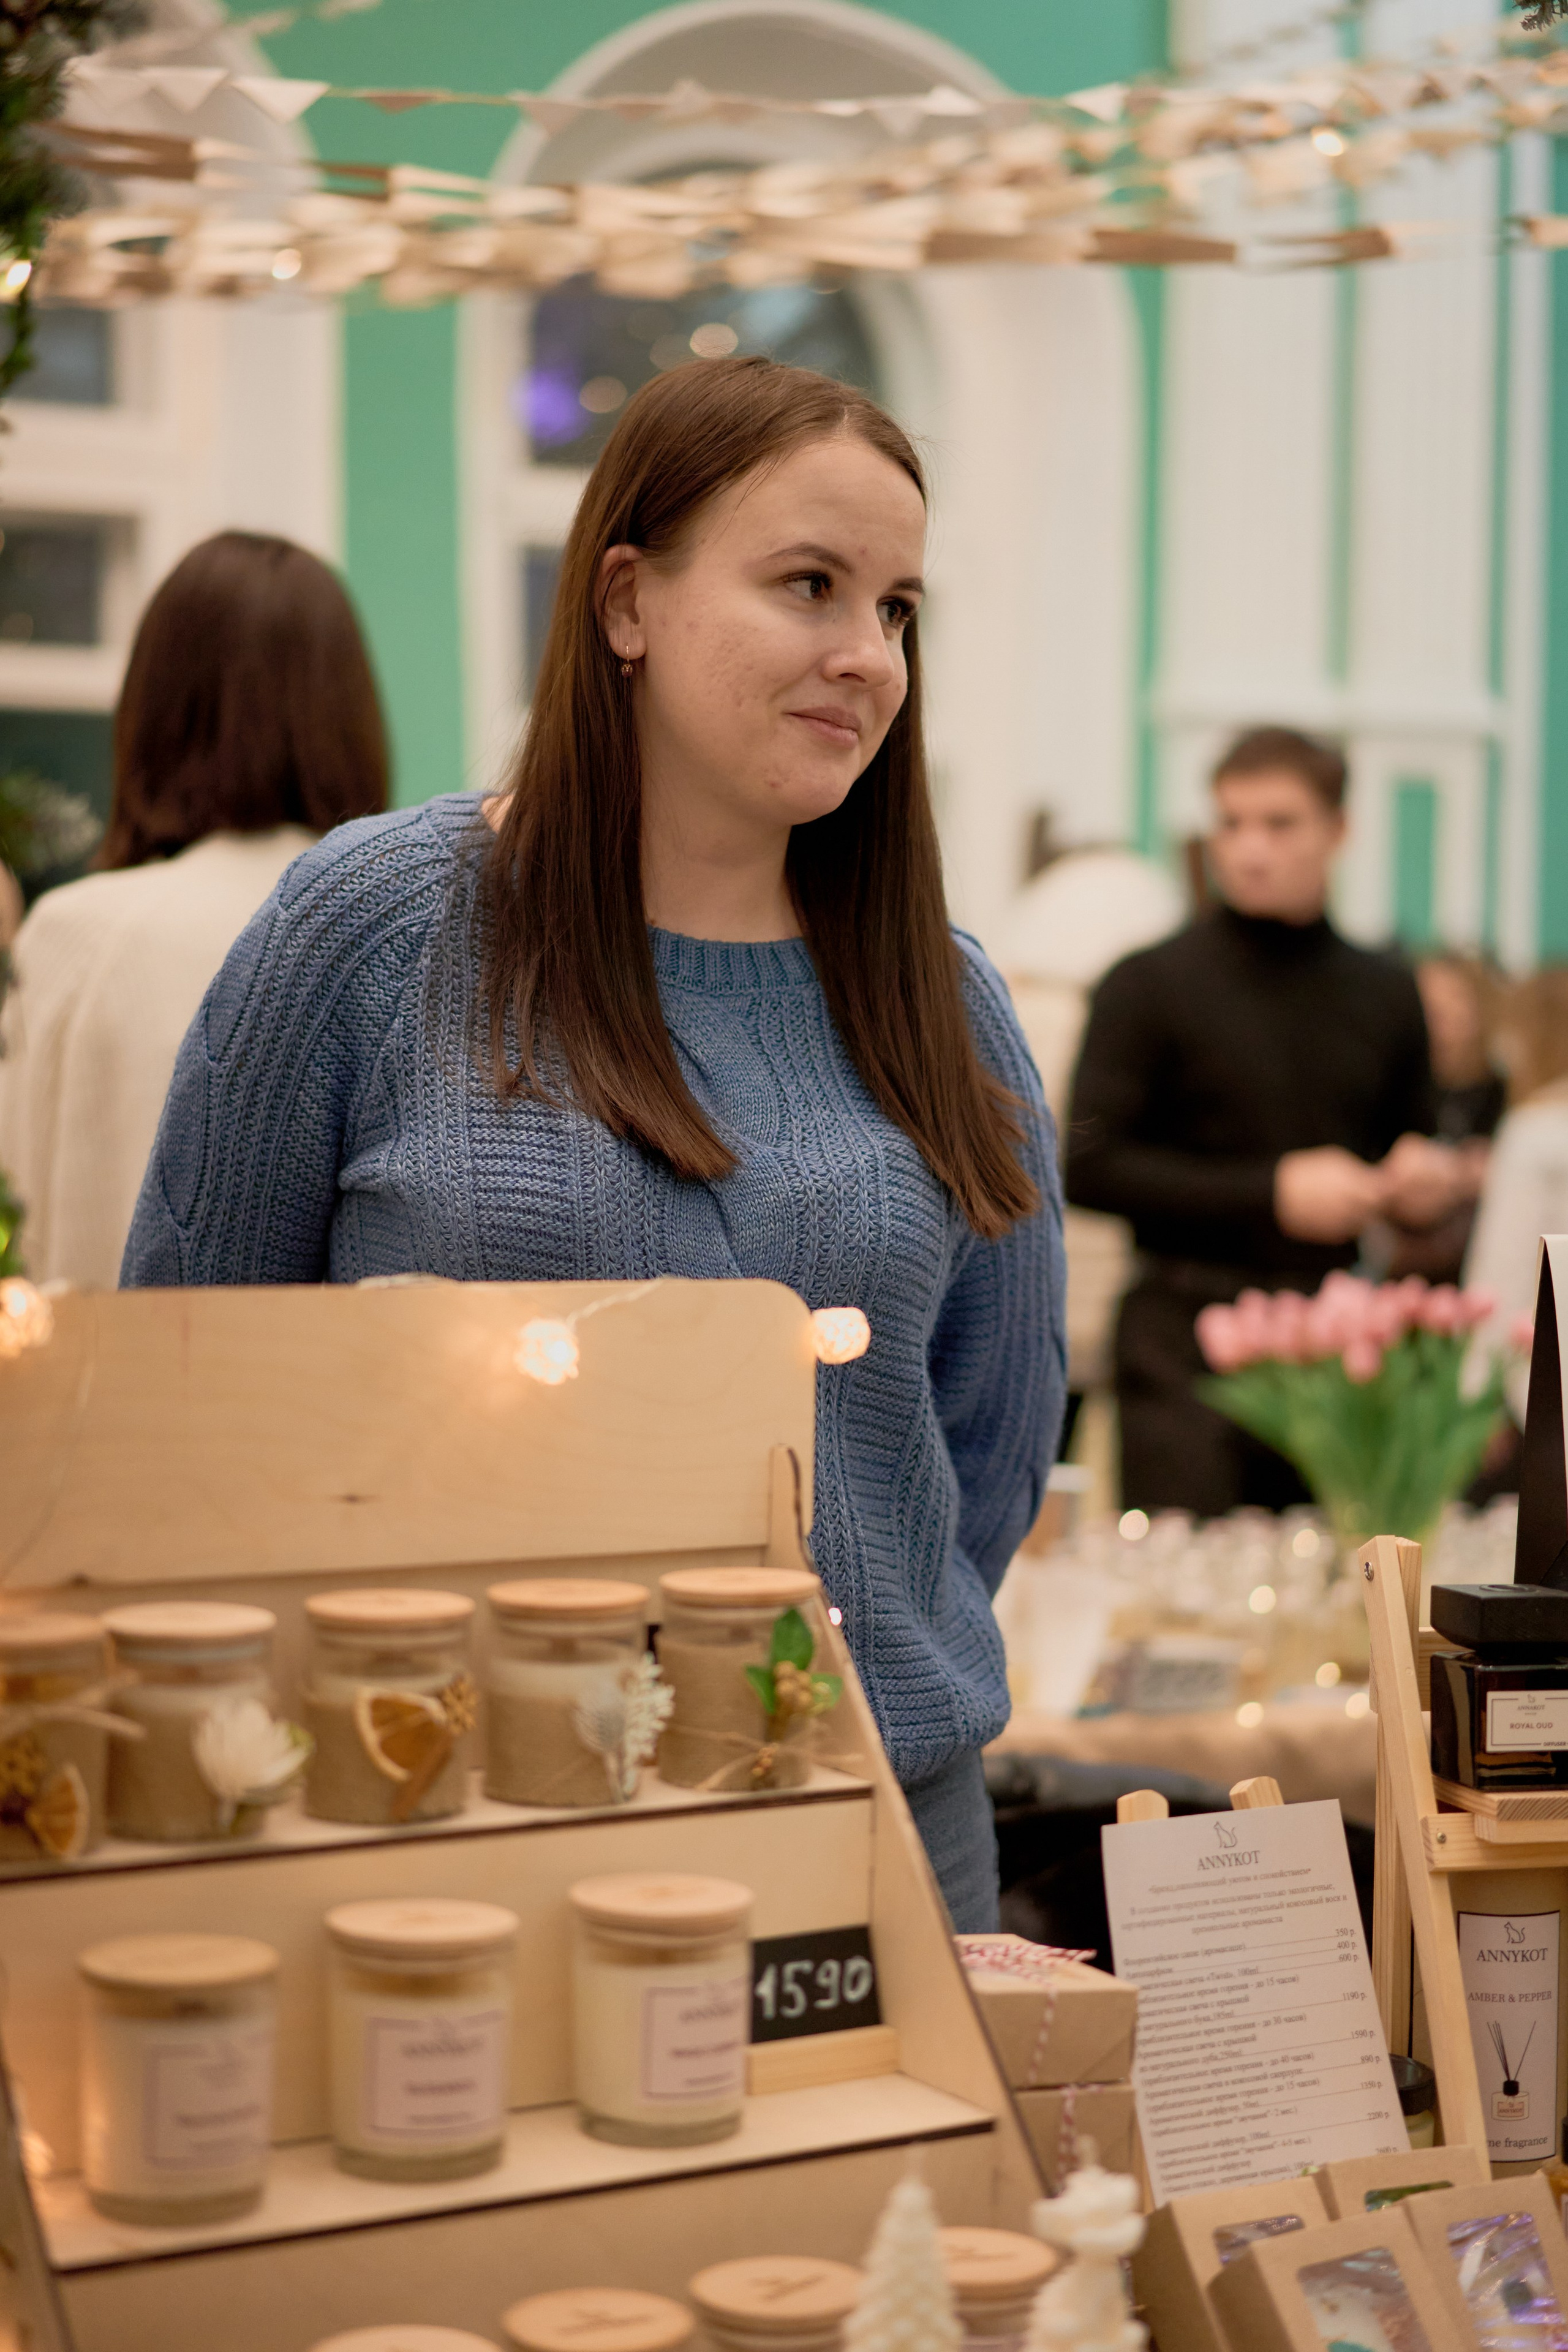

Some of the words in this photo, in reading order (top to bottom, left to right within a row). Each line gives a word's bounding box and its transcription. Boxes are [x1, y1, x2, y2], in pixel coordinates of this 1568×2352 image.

[1197, 1850, 1260, 1871] ANNYKOT
[1262, 1889, 1286, 1898] только
[1289, 1883, 1335, 1894] экологичные,
[1238, 1901, 1284, 1915] натуральный
[1286, 1896, 1324, 1907] кокосовый
[1241, 1915, 1283, 1928] аромамасла
[1201, 1943, 1246, 1956] (аромасаше)
[1335, 1928, 1348, 1937] 350
[1349, 1928, 1356, 1937] р.
[1336, 1940, 1349, 1949] 400
[1476, 1948, 1548, 1962] ANNYKOT
[1238, 1966, 1259, 1976] 100ml
[1338, 1953, 1352, 1962] 600
[754, 1955, 873, 2020] 1590
[1196, 1988, 1218, 1997] время
[1219, 1983, 1248, 1994] горения
[1276, 1975, 1299, 1985] часов)
[1215, 1994, 1250, 2007] крышкой
[1343, 1991, 1359, 2001] 1190
[1360, 1992, 1368, 2000] р.
[1468, 1992, 1505, 2003] AMBER
[1508, 1994, 1516, 2003] &
[1518, 1991, 1552, 2002] PEPPER
[1203, 2026, 1225, 2037] время
[1226, 2021, 1256, 2032] горения
[1272, 2016, 1281, 2024] 30
[1283, 2013, 1306, 2023] часов)
[1222, 2033, 1257, 2047] крышкой
[1351, 2029, 1368, 2039] 1590
[1368, 2029, 1376, 2038] р.
[1210, 2066, 1232, 2076] время
[1234, 2060, 1263, 2071] горения
[1280, 2054, 1289, 2064] 40
[1290, 2052, 1314, 2062] часов)
[1360, 2054, 1373, 2064] 890
[1374, 2055, 1382, 2064] р.
[1215, 2092, 1237, 2102] время
[1239, 2087, 1268, 2098] горения
[1286, 2081, 1294, 2089] 15
[1295, 2078, 1320, 2087] часов)
[1360, 2080, 1376, 2089] 1350
[1250, 2130, 1270, 2139] 100ml
[1367, 2111, 1383, 2120] 2200
[1504, 2136, 1548, 2149] fragrance
